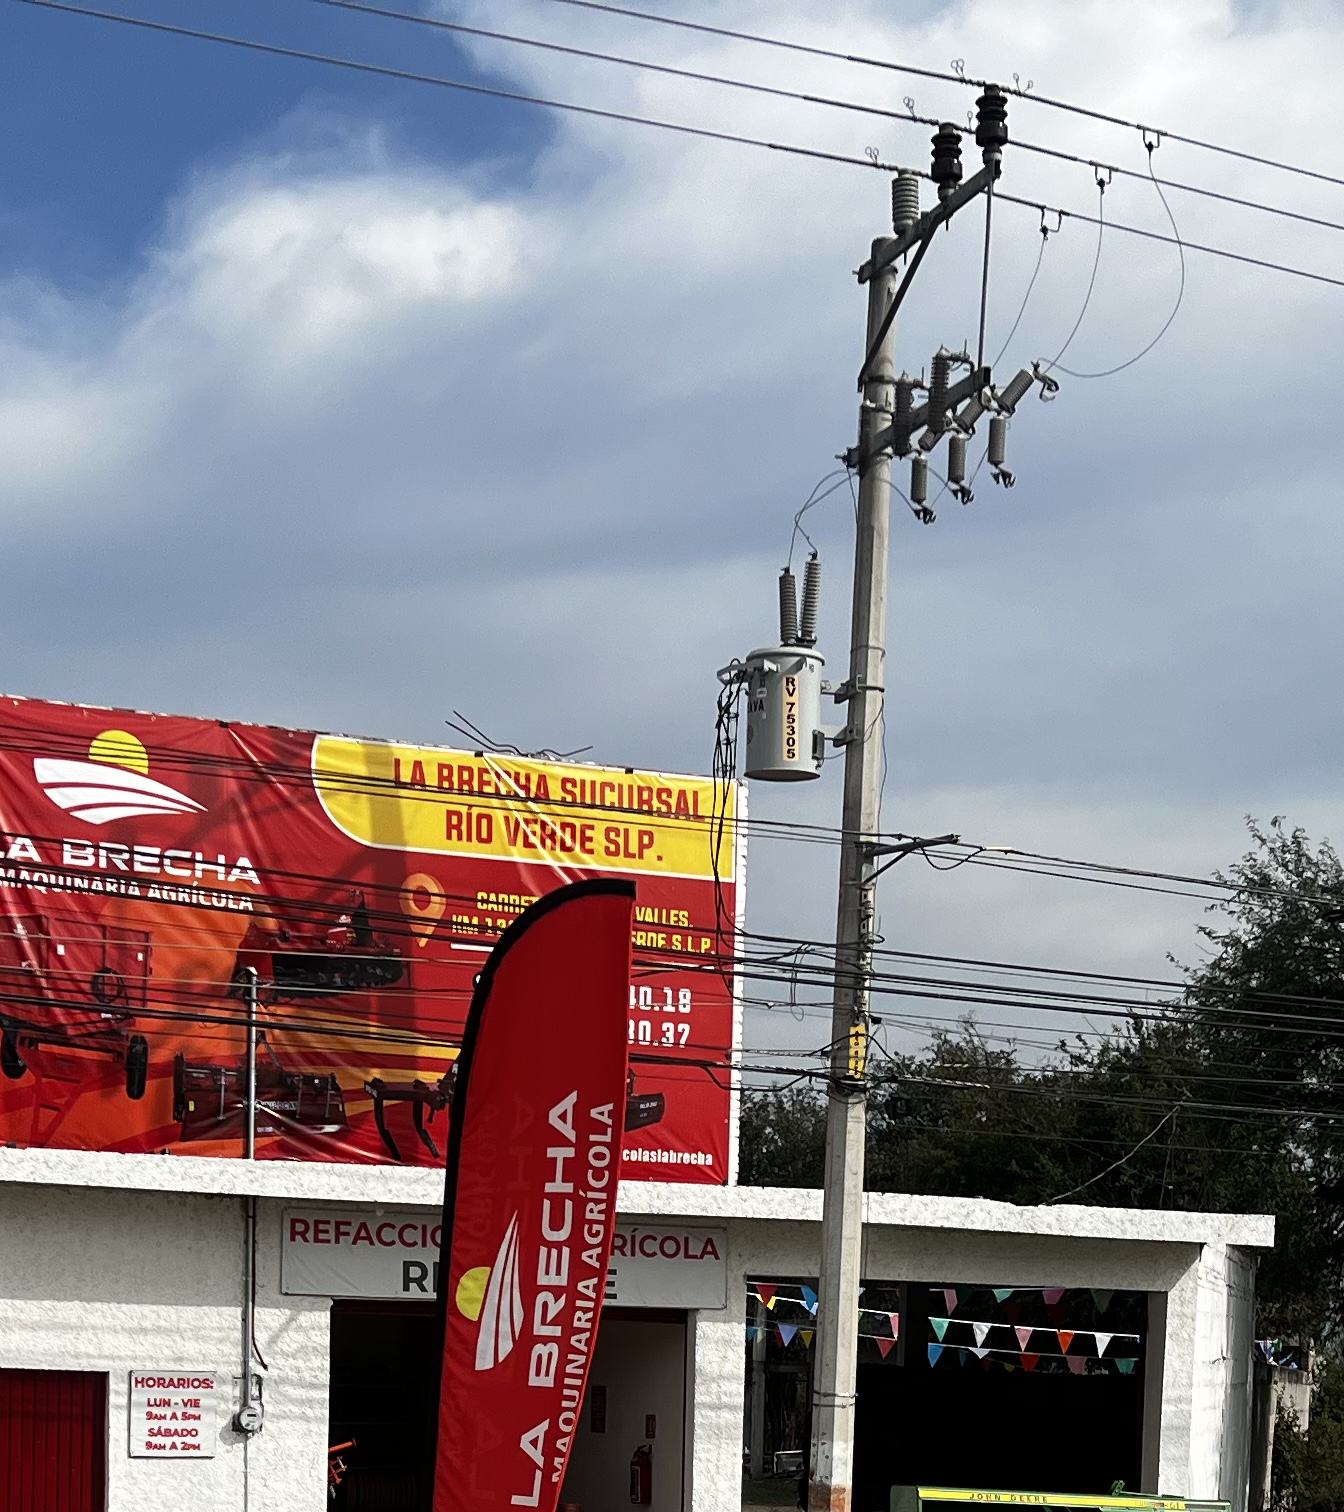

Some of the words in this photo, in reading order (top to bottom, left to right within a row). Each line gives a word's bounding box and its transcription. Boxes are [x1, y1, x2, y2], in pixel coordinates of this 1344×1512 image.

[785, 676, 797, 697] RV
[785, 702, 796, 759] 75305
[394, 757, 426, 789] LA
[436, 762, 550, 801] BRECHA
[560, 776, 706, 823] SUCURSAL
[445, 805, 494, 844] RÍO
[505, 815, 596, 855] VERDE
[604, 827, 665, 862] SLP.
[61, 837, 262, 886] BRECHA
[146, 880, 256, 912] AGRÍCOLA
[622, 1147, 713, 1166] colaslabrecha
[527, 1090, 578, 1388] BRECHA
[551, 1277, 600, 1483] MAQUINARIA
[578, 1102, 615, 1269] AGRÍCOLA
[134, 1376, 215, 1390] HORARIOS:
[146, 1397, 172, 1408] LUN
[181, 1398, 201, 1408] VIE
[169, 1411, 179, 1421] A
[147, 1425, 199, 1438] SÁBADO
[168, 1441, 179, 1451] A
[509, 1418, 551, 1508] LA
